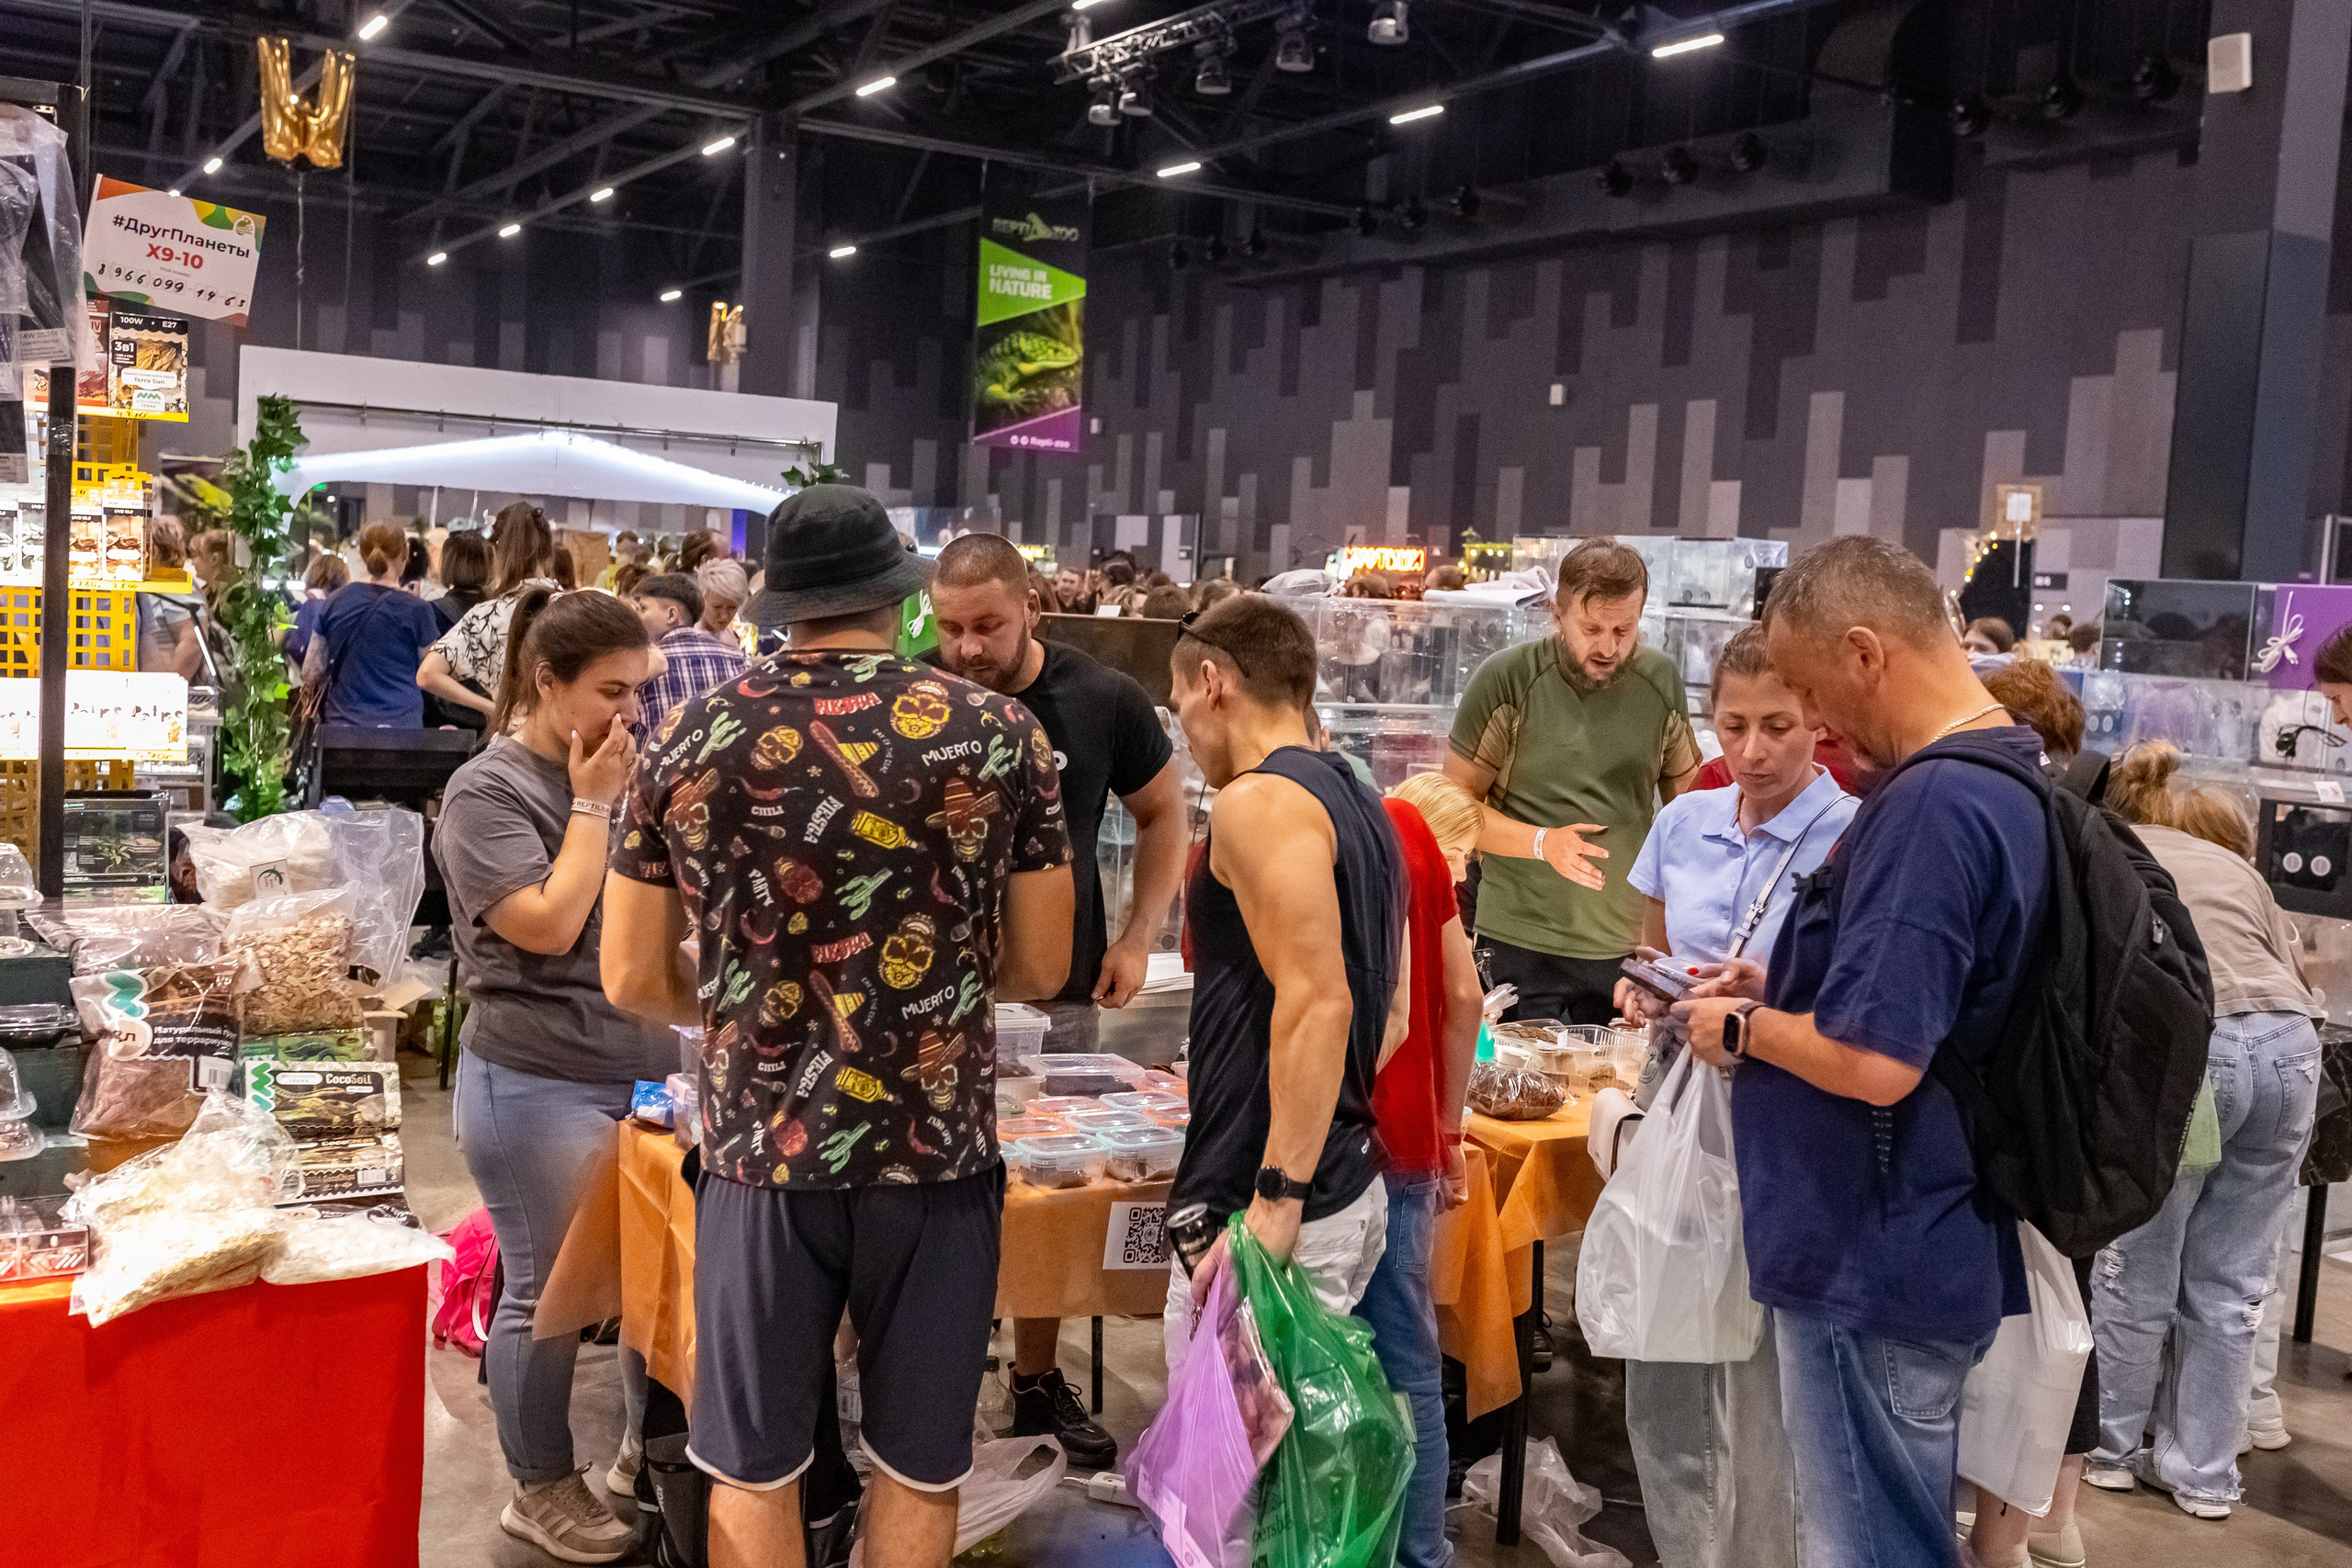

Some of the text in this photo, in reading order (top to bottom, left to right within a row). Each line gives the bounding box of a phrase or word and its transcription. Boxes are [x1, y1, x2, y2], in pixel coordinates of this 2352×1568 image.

[112, 214, 250, 258] #ДругПланеты
[989, 264, 1046, 283] LIVING IN
[989, 278, 1052, 300] NATURE
[120, 316, 177, 329] 100W E27
[922, 739, 982, 767] MUERTO
[751, 805, 786, 817] CHILI
[803, 795, 845, 844] FIESTA
[748, 868, 775, 908] PARTY
[901, 985, 956, 1021] MUERTO
[153, 1037, 175, 1045] для
[325, 1073, 373, 1085] CocoSoil
[796, 1049, 834, 1099] FIESTA
